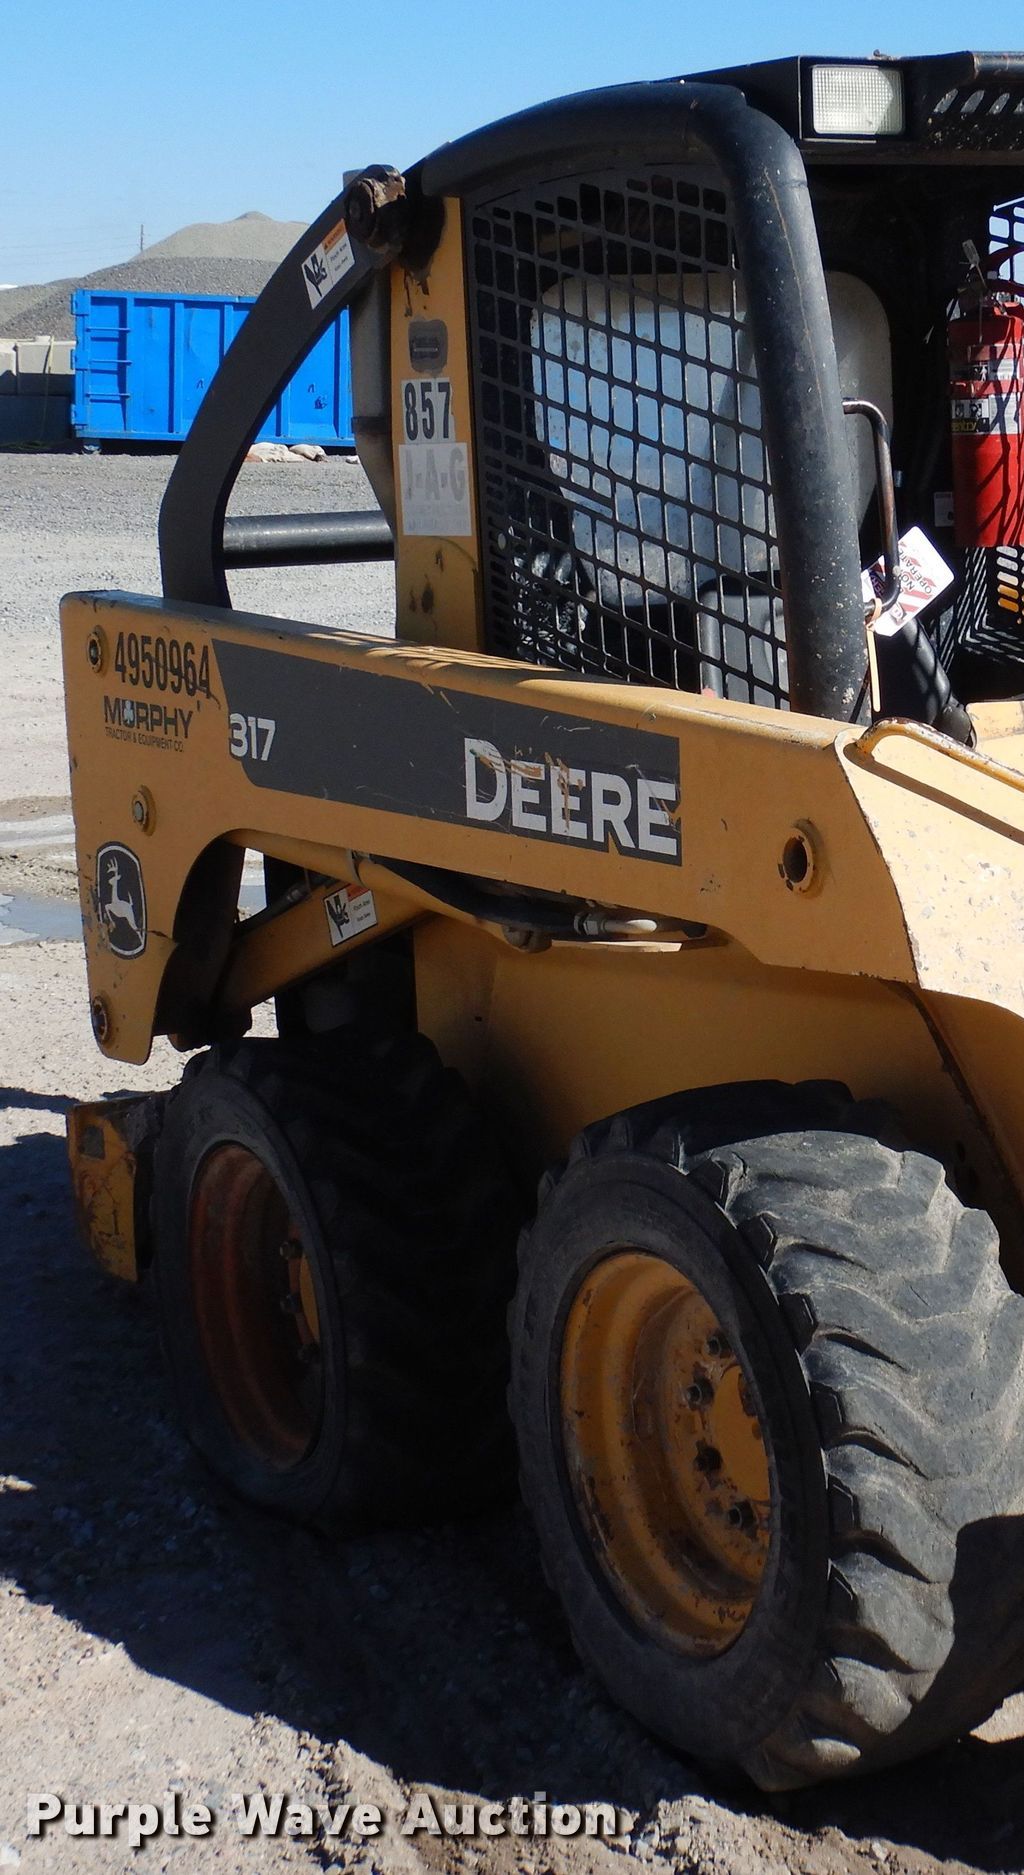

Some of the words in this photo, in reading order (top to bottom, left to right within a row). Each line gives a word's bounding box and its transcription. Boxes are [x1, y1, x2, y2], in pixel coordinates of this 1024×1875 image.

[404, 381, 451, 441] 857
[115, 632, 210, 699] 4950964
[104, 695, 193, 739] MURPHY
[105, 726, 132, 741] TRACTOR
[229, 713, 276, 761] 317
[464, 737, 678, 856] DEERE
